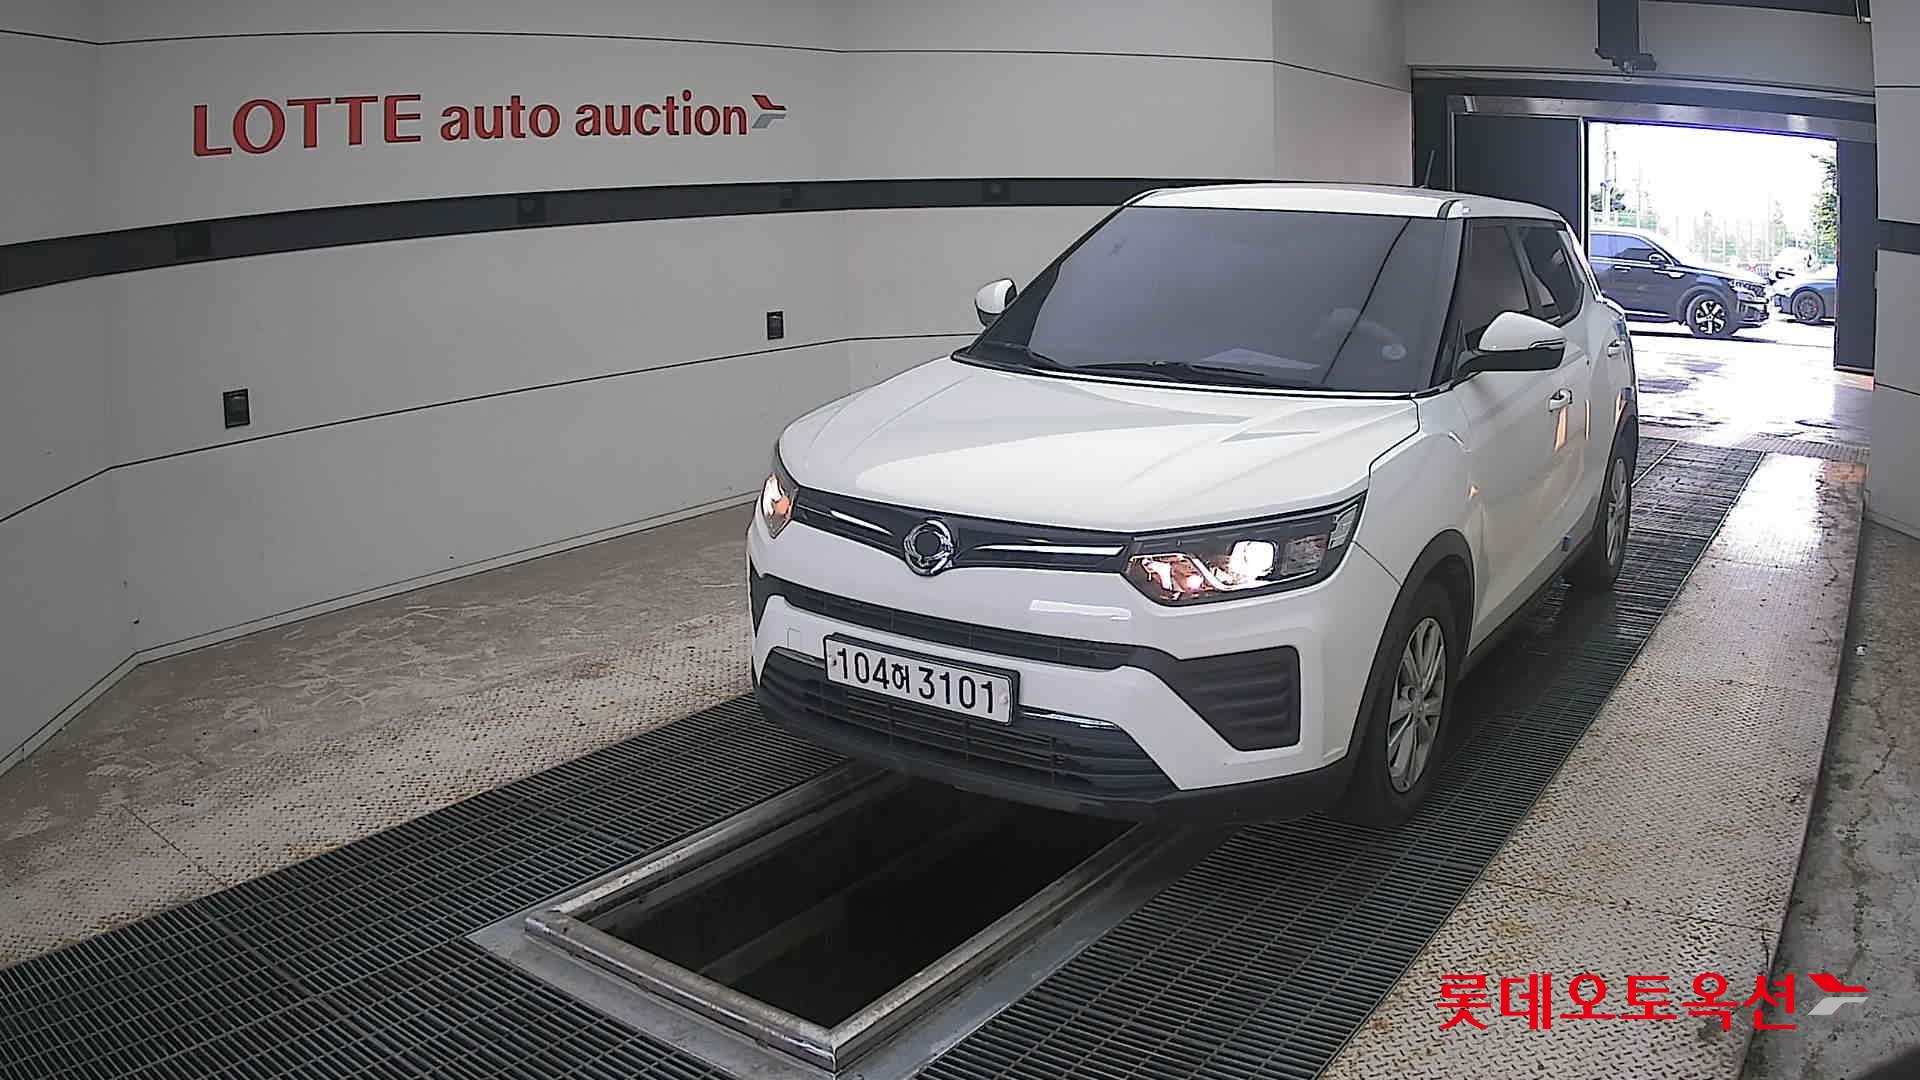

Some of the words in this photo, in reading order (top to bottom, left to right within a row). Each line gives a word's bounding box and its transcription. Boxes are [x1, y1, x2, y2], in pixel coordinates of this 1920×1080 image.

[193, 94, 422, 157] LOTTE
[440, 95, 561, 141] auto
[575, 89, 748, 137] auction
[837, 647, 911, 694] 104허
[918, 665, 994, 714] 3101
